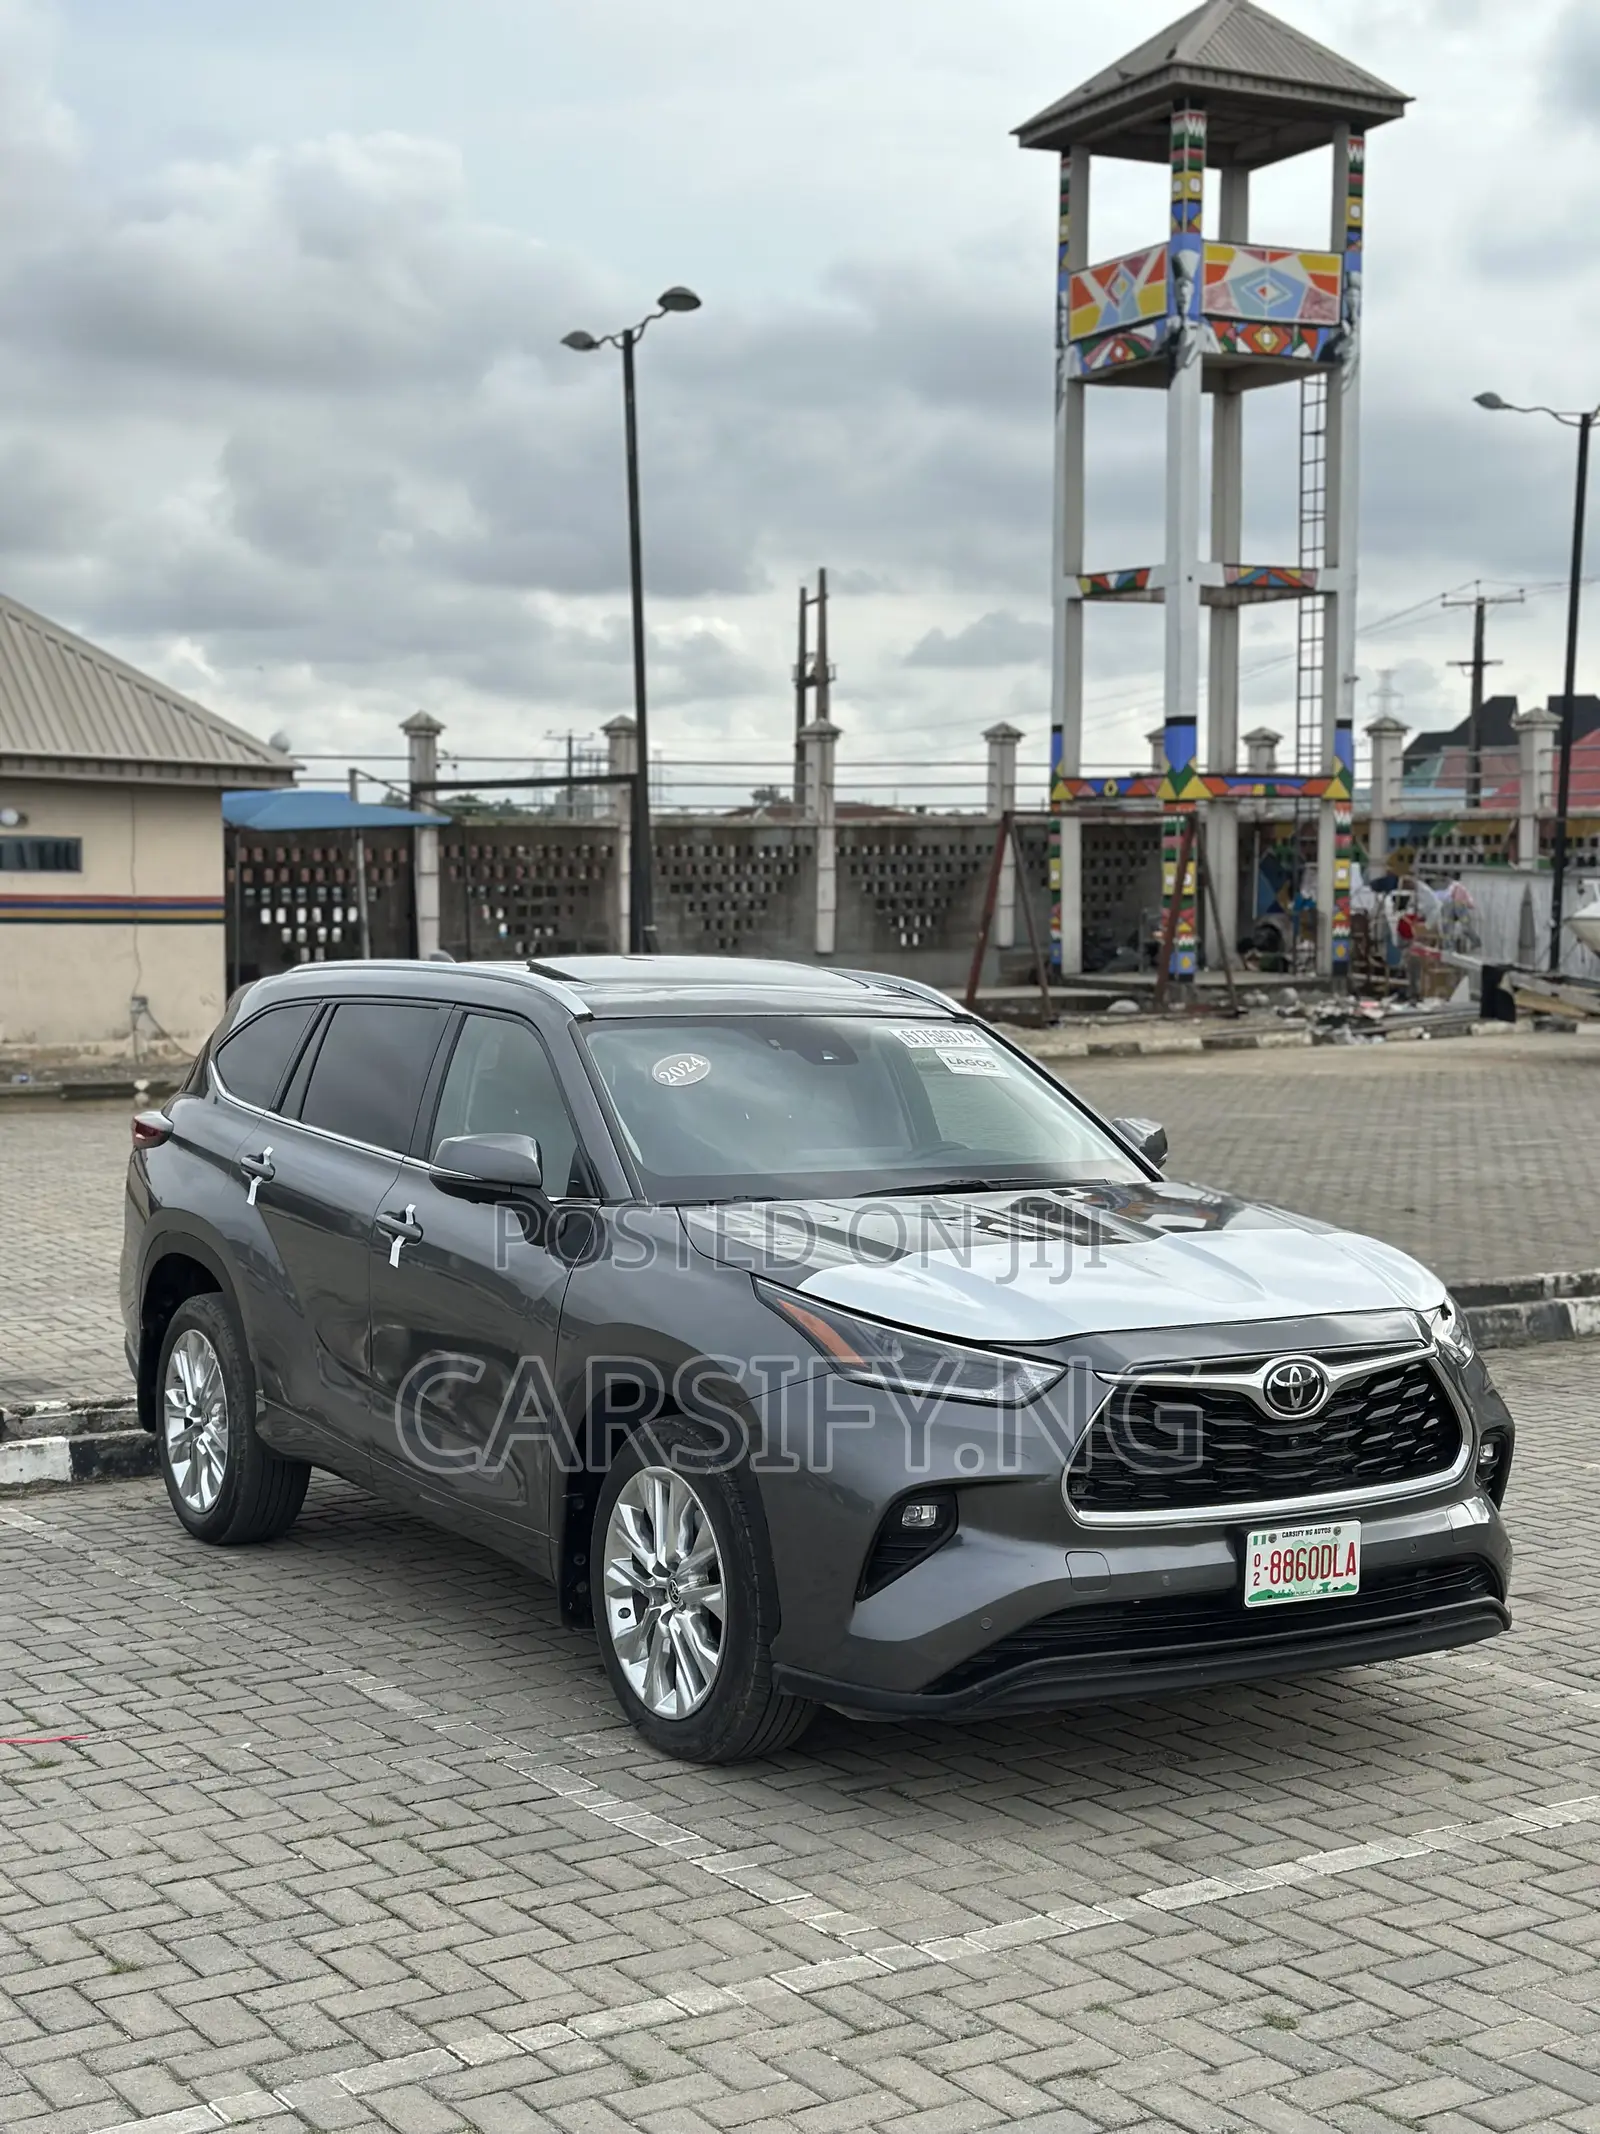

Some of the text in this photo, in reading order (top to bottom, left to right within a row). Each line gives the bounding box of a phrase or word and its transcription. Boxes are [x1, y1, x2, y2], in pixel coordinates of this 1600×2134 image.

[946, 1057, 996, 1068] LAGOS
[658, 1055, 707, 1084] 2024
[1281, 1529, 1304, 1539] CARSIFY
[1313, 1526, 1332, 1535] AUTOS
